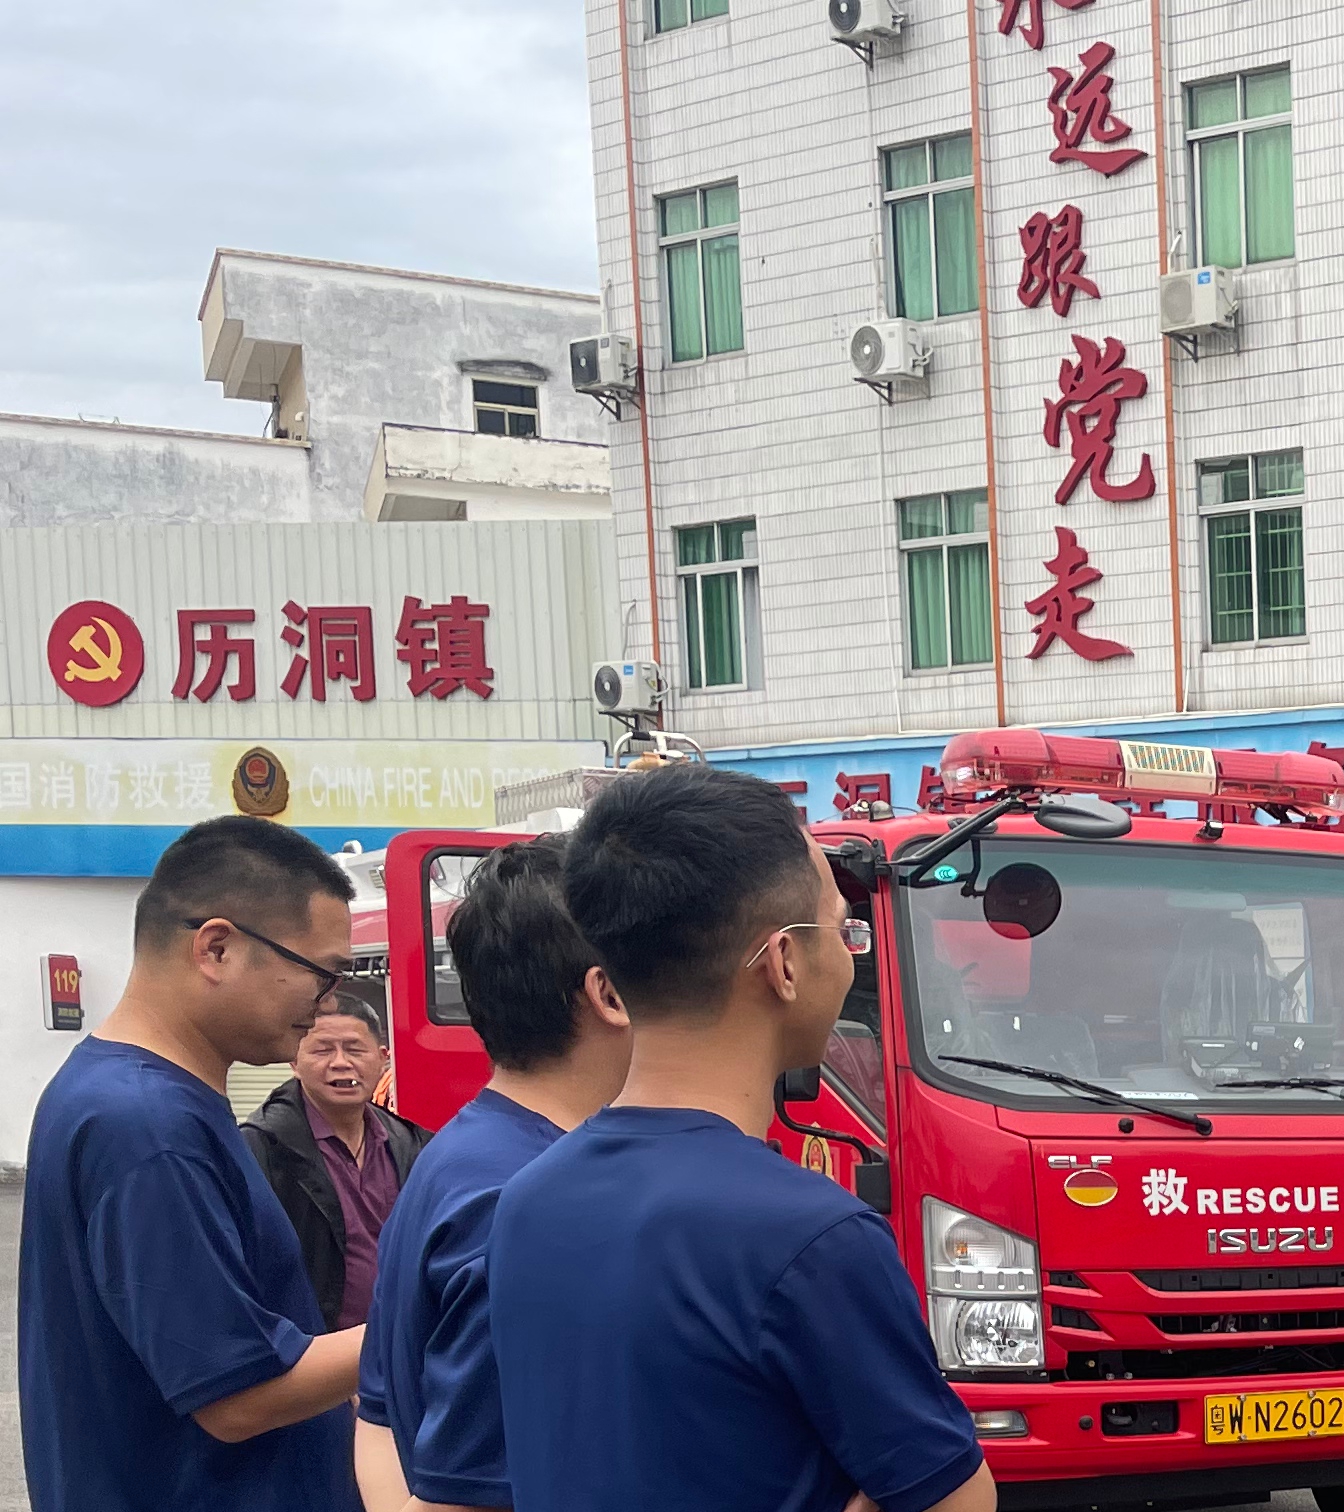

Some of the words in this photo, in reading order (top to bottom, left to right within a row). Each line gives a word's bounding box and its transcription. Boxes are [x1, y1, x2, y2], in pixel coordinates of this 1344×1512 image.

[171, 595, 494, 702] 历洞镇
[309, 766, 377, 809] CHINA
[384, 767, 433, 808] FIRE
[441, 767, 485, 808] AND
[54, 968, 79, 993] 119
[1196, 1186, 1340, 1215] RESCUE
[1207, 1226, 1334, 1254] ISUZU
